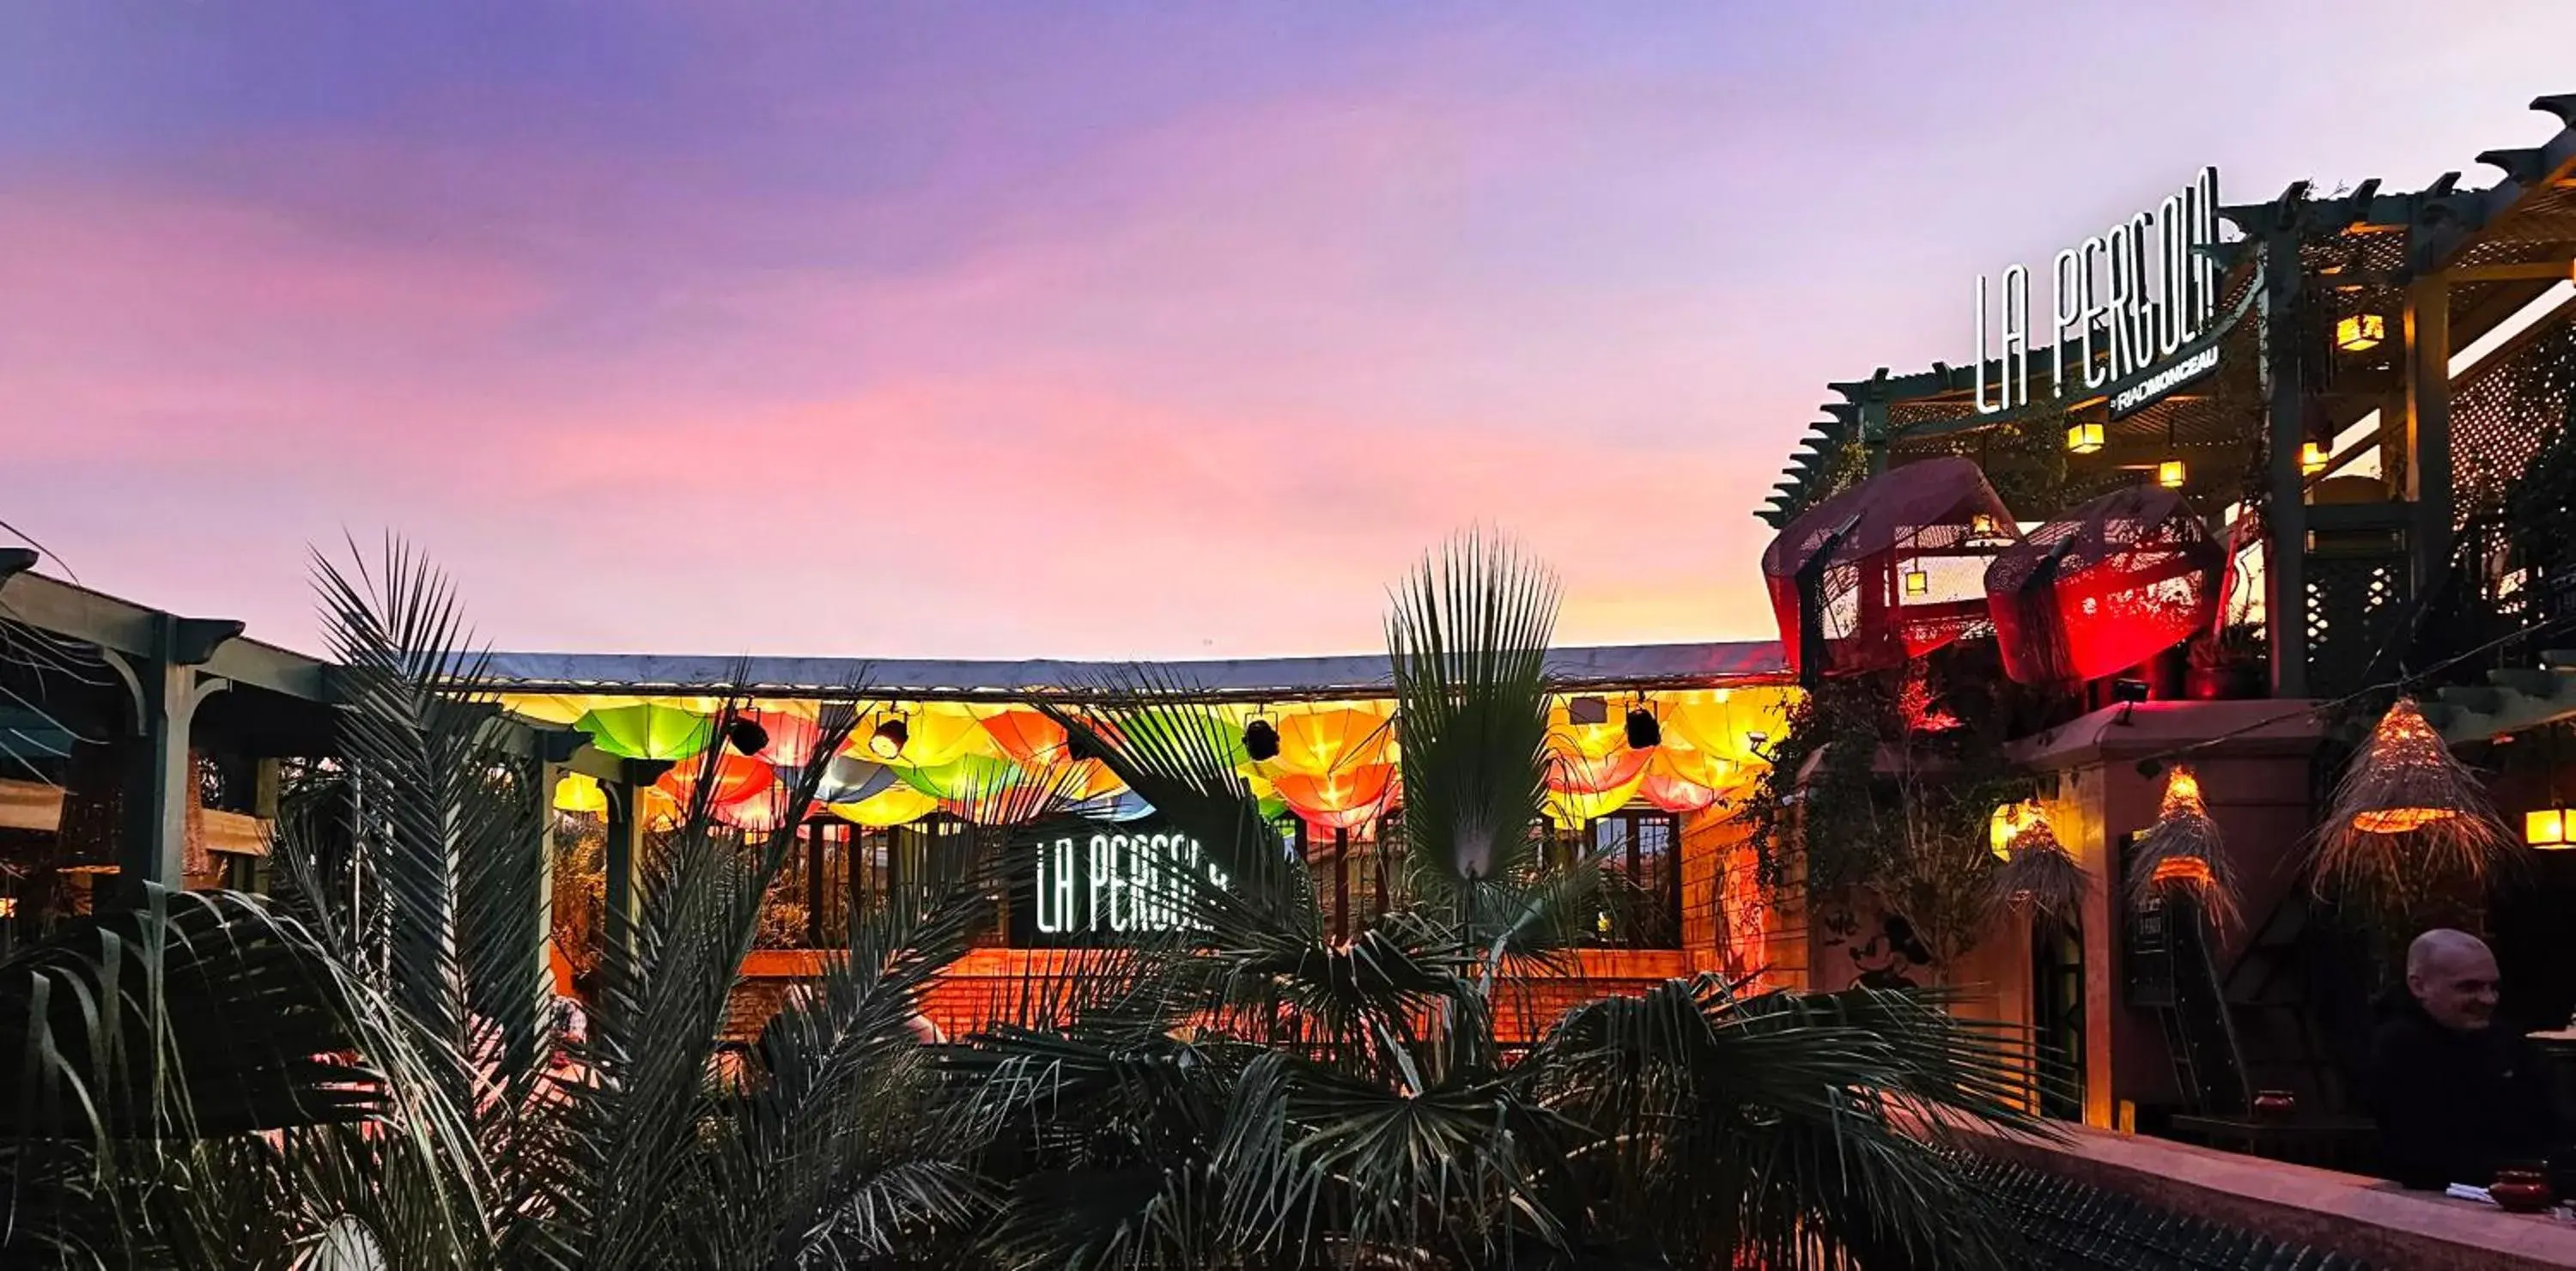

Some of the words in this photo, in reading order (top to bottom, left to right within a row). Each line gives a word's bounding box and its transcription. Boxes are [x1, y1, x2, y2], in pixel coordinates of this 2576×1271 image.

[1977, 264, 2029, 414] LA
[2053, 166, 2215, 397] PERGOLA
[1036, 838, 1072, 933] LA
[1090, 835, 1228, 933] PERGOL
